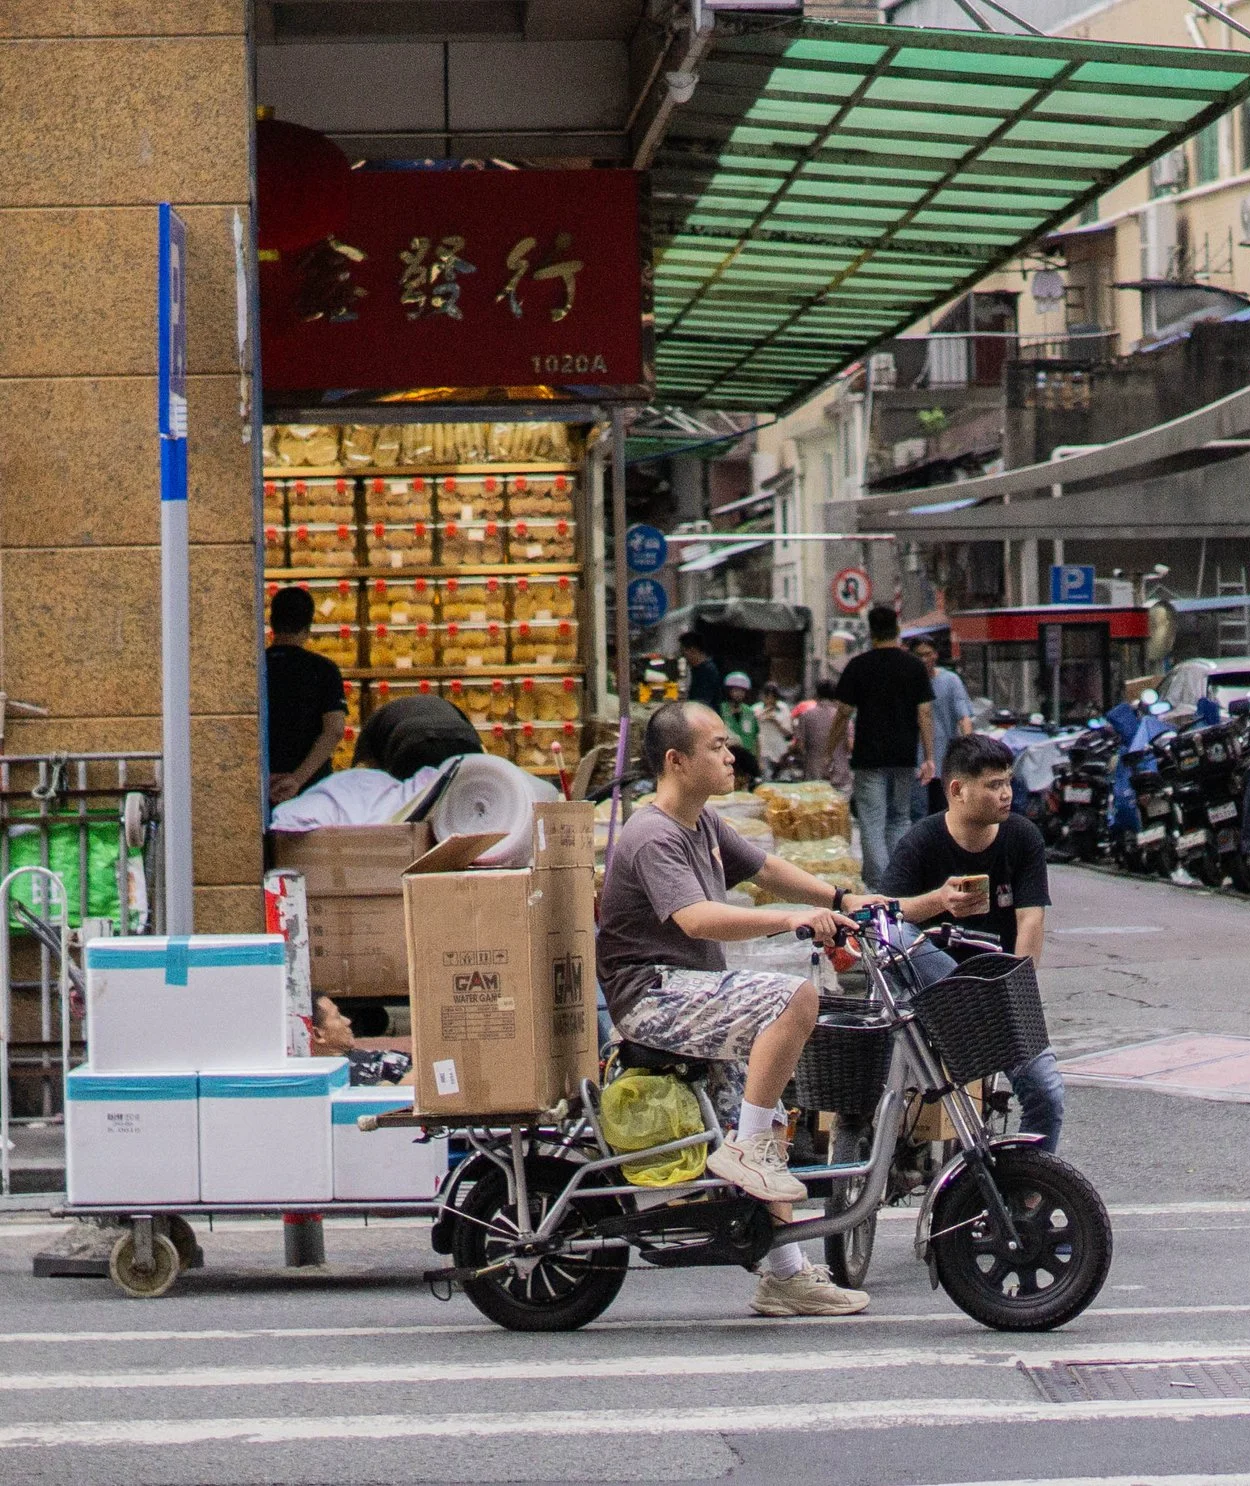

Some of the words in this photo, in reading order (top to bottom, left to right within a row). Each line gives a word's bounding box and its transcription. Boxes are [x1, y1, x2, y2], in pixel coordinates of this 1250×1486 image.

[531, 354, 608, 374] 1020A
[1061, 568, 1085, 601] P
[455, 971, 498, 991] GAM
[554, 953, 582, 1004] GAM
